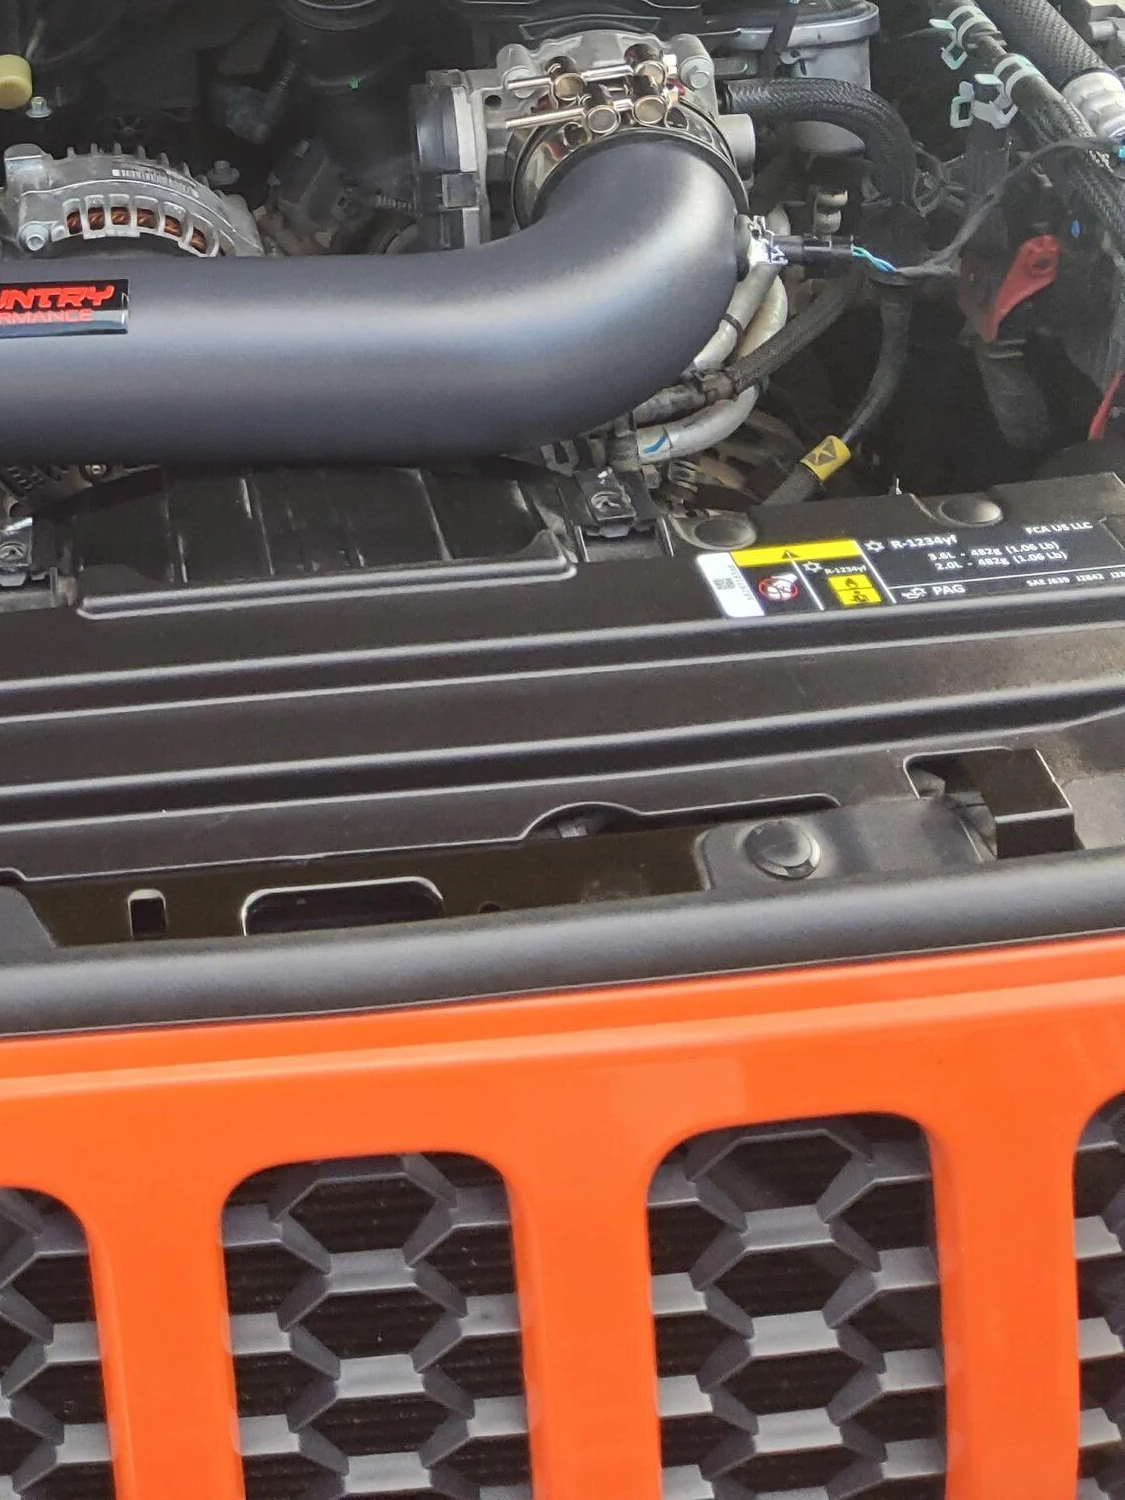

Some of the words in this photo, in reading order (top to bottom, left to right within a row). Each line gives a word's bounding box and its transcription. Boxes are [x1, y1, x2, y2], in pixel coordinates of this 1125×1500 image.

[1025, 525, 1051, 535] FCA
[1050, 523, 1070, 532] US
[1070, 521, 1094, 531] LLC
[889, 534, 958, 550] R-1234yf
[927, 552, 956, 561] 3.6L
[970, 547, 1003, 557] 482g
[1005, 543, 1038, 555] (1.06
[1038, 541, 1060, 550] Lb)
[935, 561, 963, 571] 2.0L
[977, 557, 1010, 567] 482g
[1012, 552, 1045, 564] (1.06
[1046, 550, 1068, 560] Lb)
[931, 584, 966, 597] PAG
